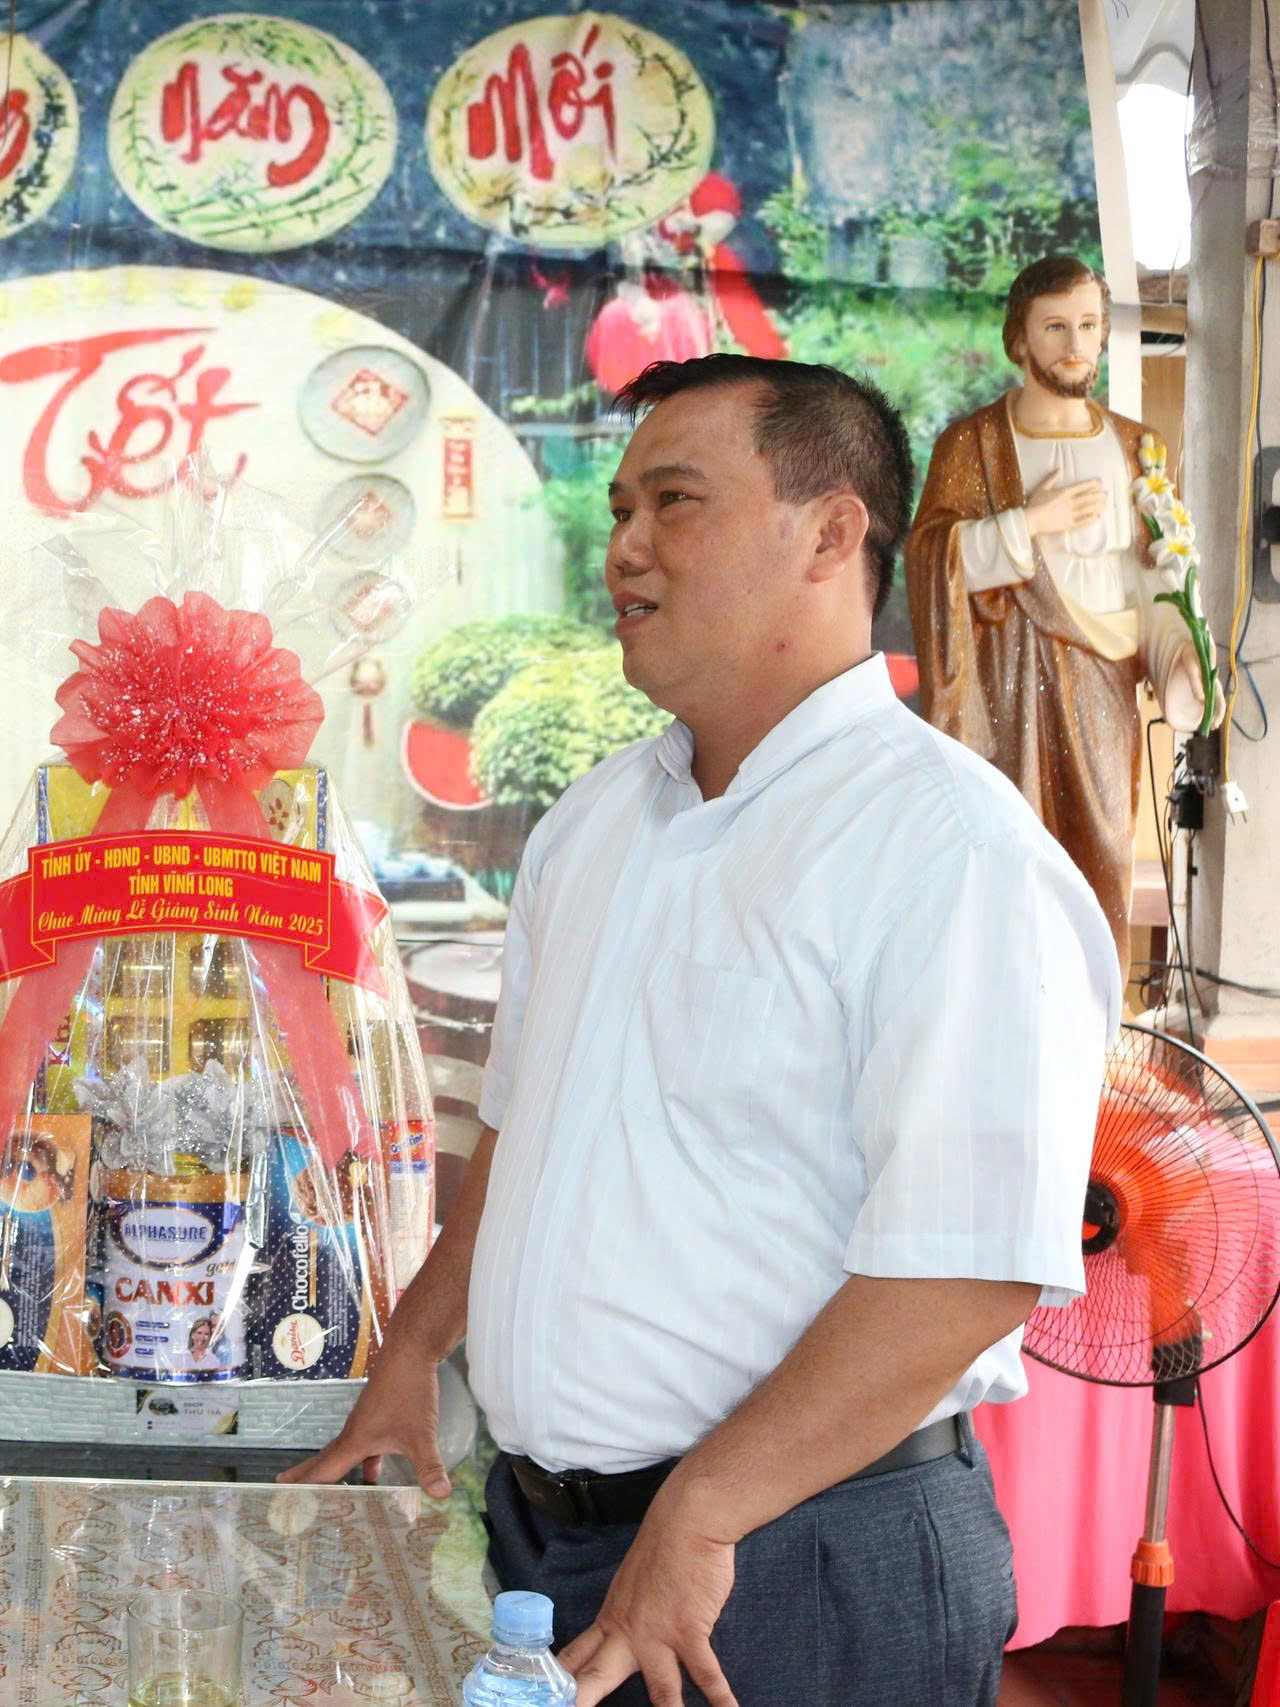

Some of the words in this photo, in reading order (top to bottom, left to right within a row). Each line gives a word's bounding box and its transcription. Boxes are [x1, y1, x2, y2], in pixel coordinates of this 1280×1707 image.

[161, 61, 330, 188] Năm
[41, 851, 72, 880] TỈNH
[75, 847, 93, 873] ỦY
[104, 846, 141, 870] HĐND
[153, 845, 191, 865] UBND
[203, 847, 257, 873] UBMTTQ
[260, 850, 288, 879] VIỆT
[291, 857, 322, 883] NAM
[129, 869, 160, 896] TỈNH
[163, 870, 195, 895] VĨNH
[198, 875, 234, 897] LONG
[38, 911, 74, 932] Chúc
[77, 904, 121, 926] Mừng
[126, 899, 146, 919] Lễ
[151, 898, 200, 923] Giáng
[203, 900, 240, 922] Sinh
[244, 904, 285, 929] Năm
[287, 913, 324, 936] 2025
[124, 1223, 208, 1240] ALPHASURE
[291, 1224, 309, 1311] Chocofello
[114, 1276, 215, 1306] CANXI
